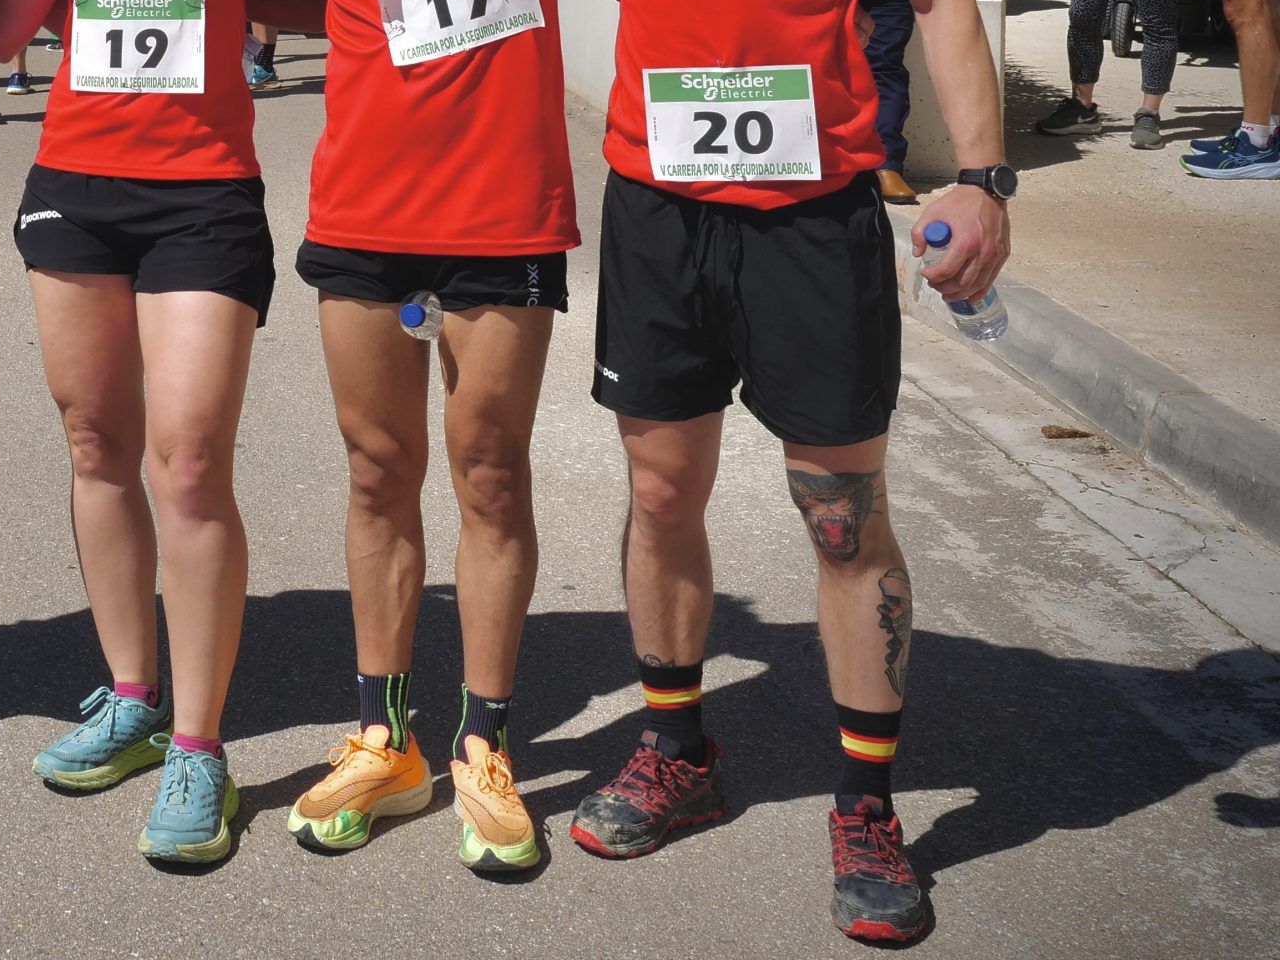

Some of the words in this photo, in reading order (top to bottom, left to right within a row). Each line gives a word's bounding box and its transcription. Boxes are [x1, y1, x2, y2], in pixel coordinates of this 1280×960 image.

[126, 8, 171, 17] Electric
[399, 49, 406, 61] V
[406, 42, 440, 60] CARRERA
[440, 36, 455, 51] POR
[455, 33, 467, 46] LA
[466, 22, 505, 42] SEGURIDAD
[505, 11, 539, 31] LABORAL
[105, 28, 169, 69] 19
[76, 76, 81, 87] V
[81, 76, 105, 88] CARRERA
[106, 76, 119, 88] POR
[120, 76, 128, 88] LA
[129, 76, 168, 89] SEGURIDAD
[168, 77, 199, 88] LABORAL
[680, 73, 774, 89] Schneider
[721, 89, 774, 99] Electric
[693, 110, 774, 155] 20
[660, 164, 667, 177] V
[667, 164, 701, 177] CARRERA
[703, 163, 720, 176] POR
[720, 163, 730, 175] LA
[731, 162, 775, 176] SEGURIDAD
[777, 161, 814, 175] LABORAL
